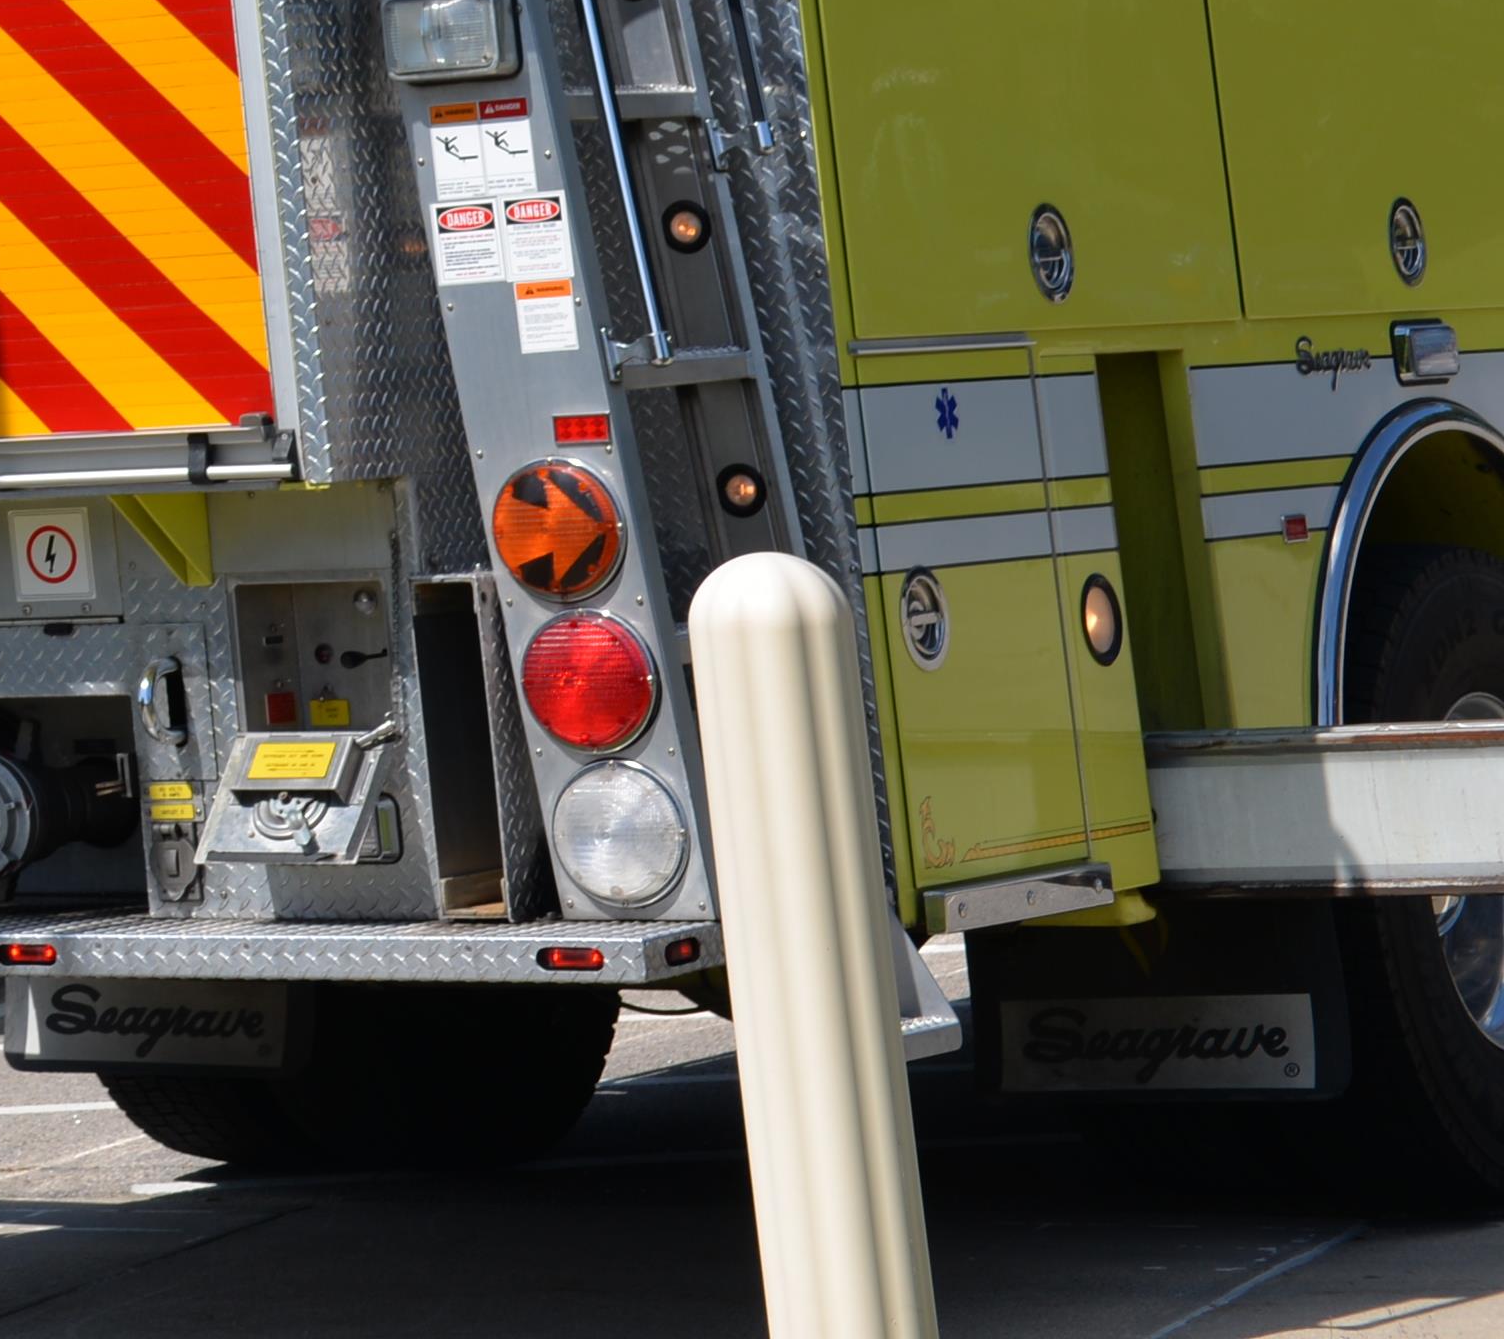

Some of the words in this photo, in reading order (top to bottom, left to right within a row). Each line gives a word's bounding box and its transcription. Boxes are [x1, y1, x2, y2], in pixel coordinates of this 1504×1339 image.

[495, 102, 520, 111] DANGER
[446, 210, 485, 227] DANGER
[513, 203, 552, 219] DANGER
[45, 983, 264, 1057] Seagrave
[1022, 1007, 1290, 1084] Seagrave
